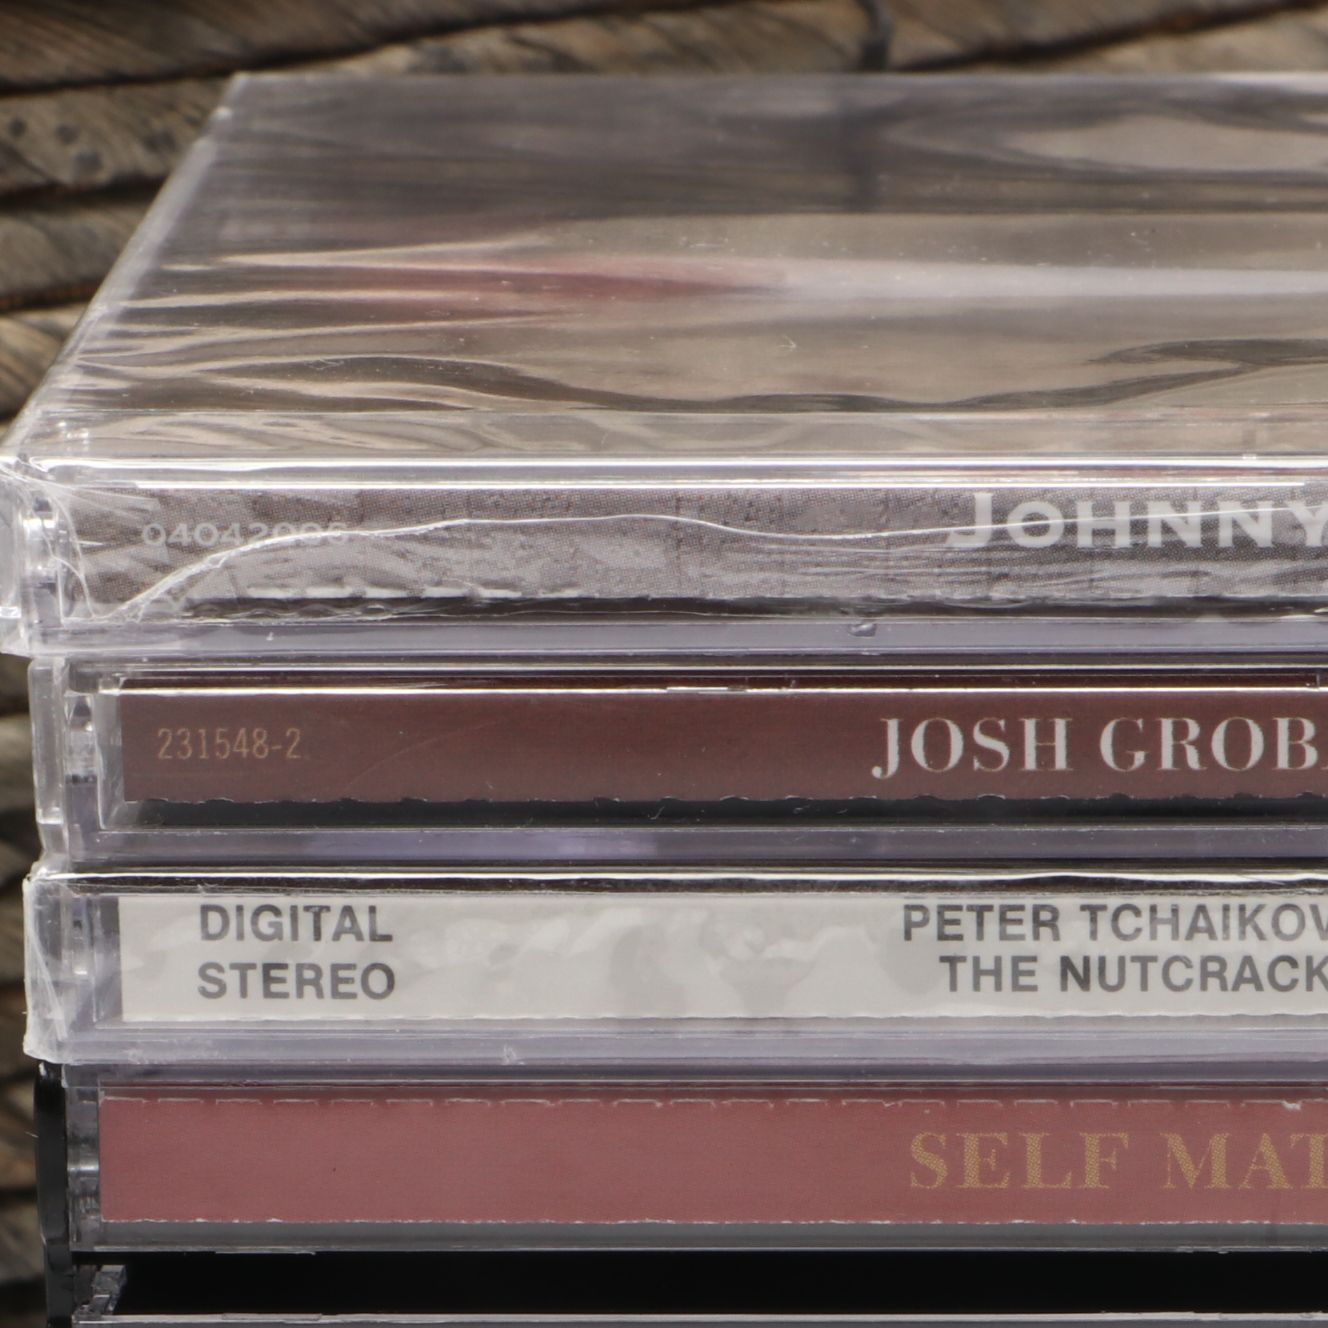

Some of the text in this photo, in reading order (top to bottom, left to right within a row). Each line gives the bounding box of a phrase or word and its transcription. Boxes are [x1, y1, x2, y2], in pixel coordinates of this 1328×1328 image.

[157, 727, 303, 761] 231548-2
[871, 717, 1074, 779] JOSH
[200, 904, 393, 943] DIGITAL
[904, 904, 1060, 941] PETER
[197, 962, 395, 1000] STEREO
[940, 955, 1039, 992] THE
[909, 1132, 1130, 1191] SELF
